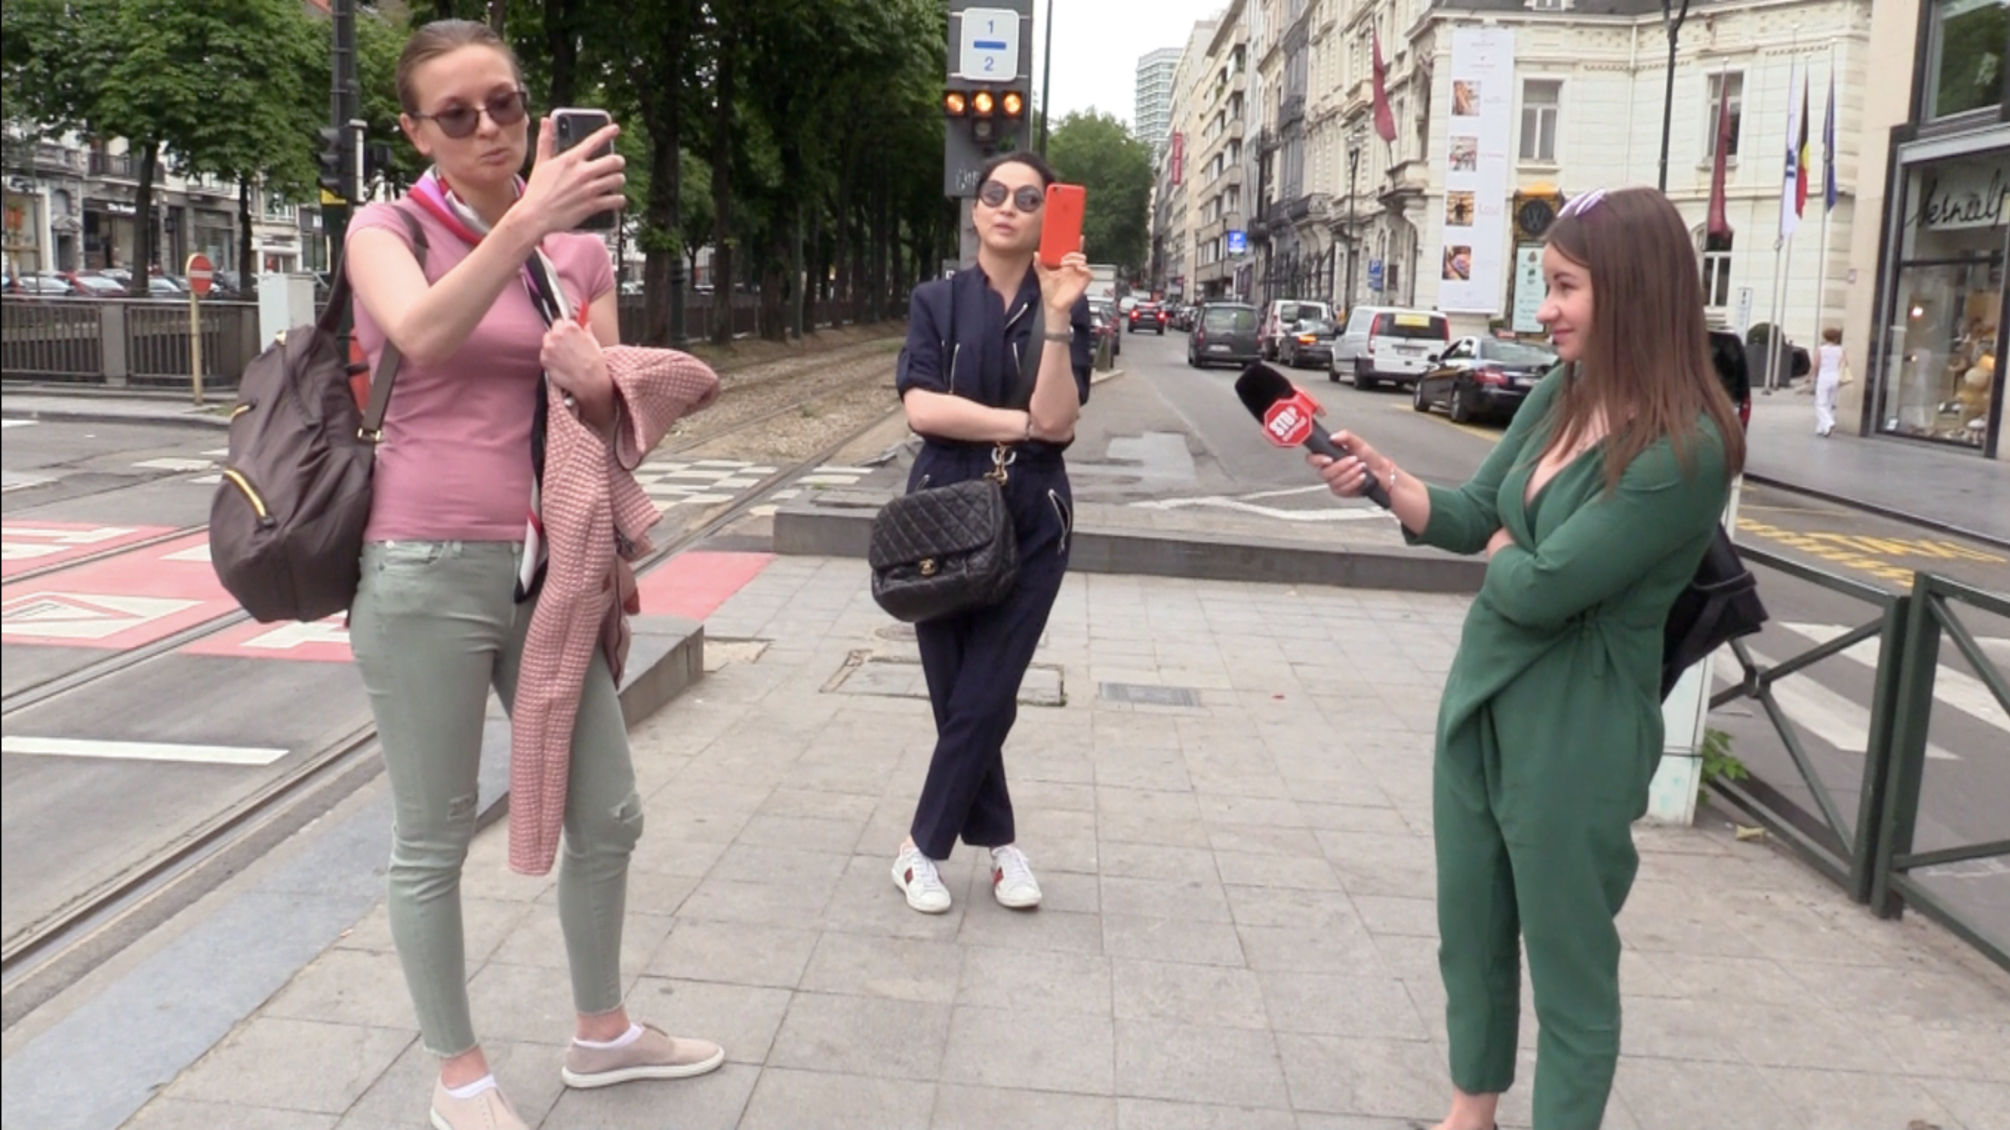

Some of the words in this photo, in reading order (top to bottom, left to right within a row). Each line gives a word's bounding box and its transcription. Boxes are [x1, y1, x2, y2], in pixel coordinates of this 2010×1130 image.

[986, 19, 994, 35] 1
[984, 56, 994, 72] 2
[1269, 406, 1299, 436] STOP
